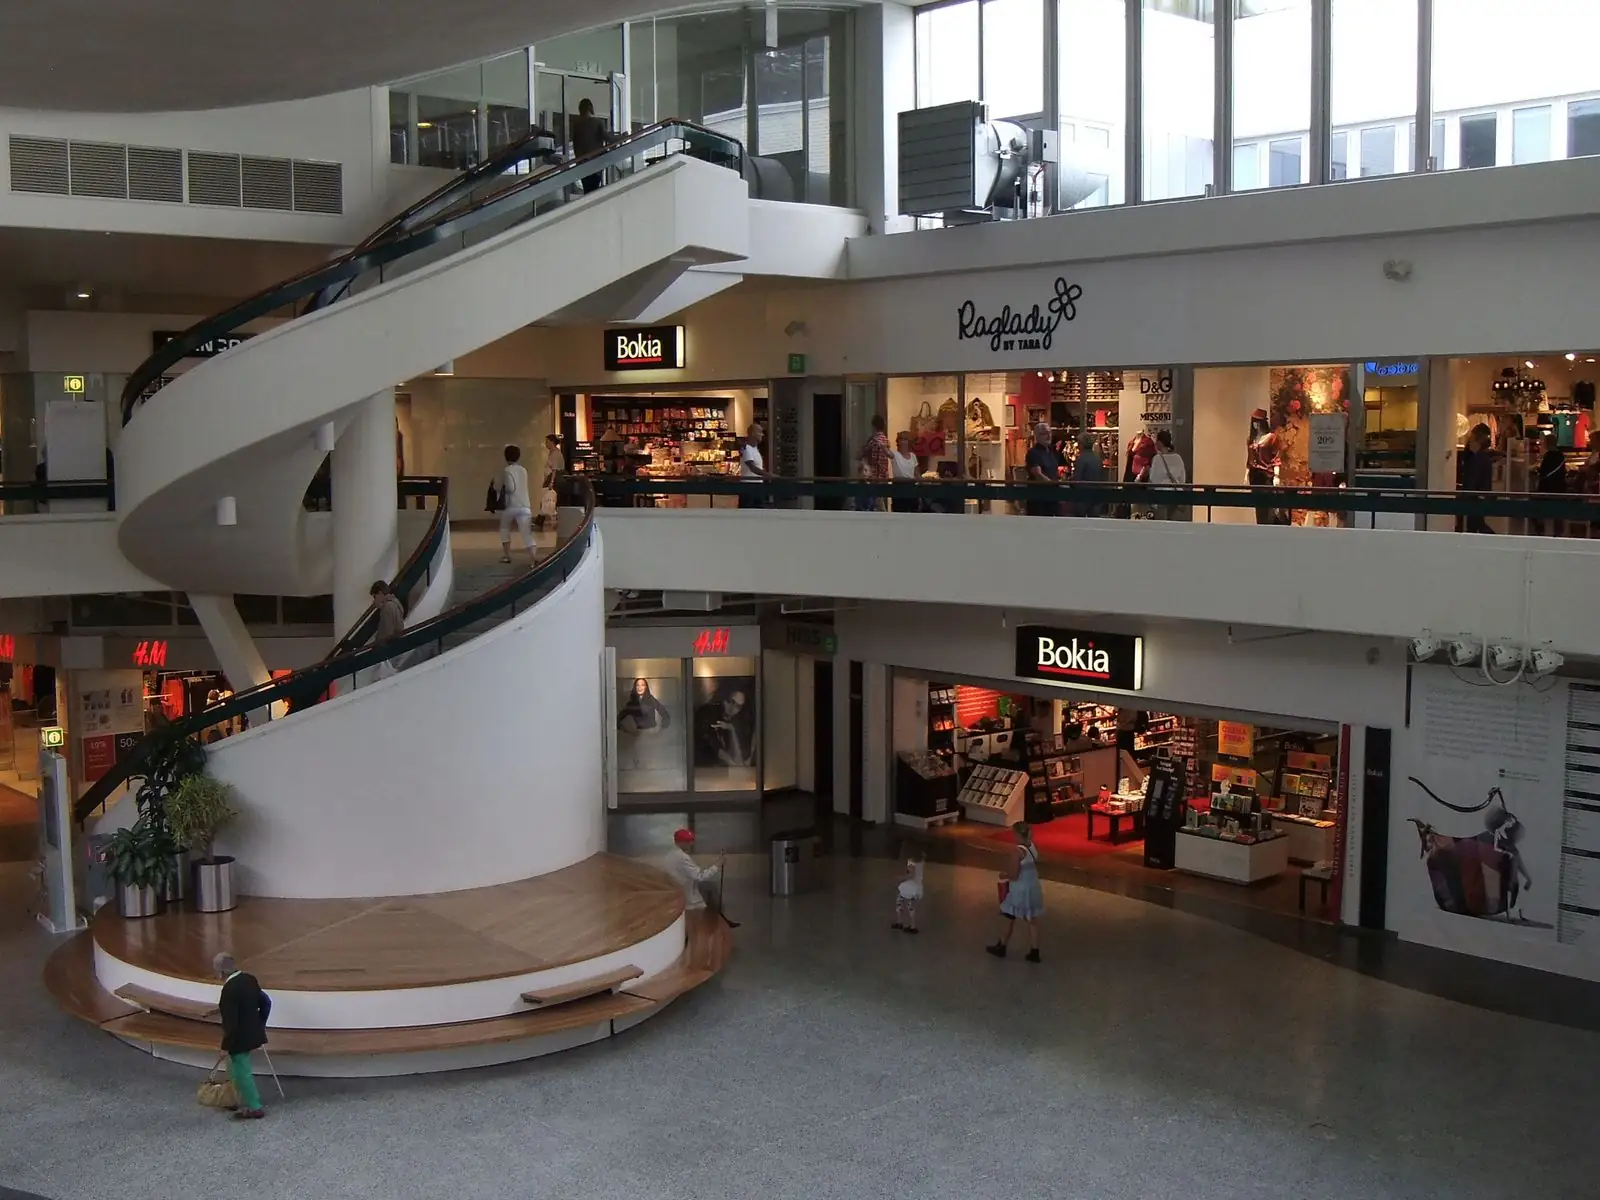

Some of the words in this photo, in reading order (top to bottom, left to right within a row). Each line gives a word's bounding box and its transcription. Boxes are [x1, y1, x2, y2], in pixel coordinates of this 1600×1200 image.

[957, 300, 1057, 351] Raglady
[617, 333, 662, 359] Bokia
[1003, 340, 1015, 351] BY
[1018, 339, 1041, 351] TARA
[1140, 377, 1172, 394] D&G
[1140, 412, 1171, 422] MISSONI
[131, 639, 167, 667] H&M
[692, 627, 730, 656] H&M
[1037, 636, 1110, 673] Bokia
